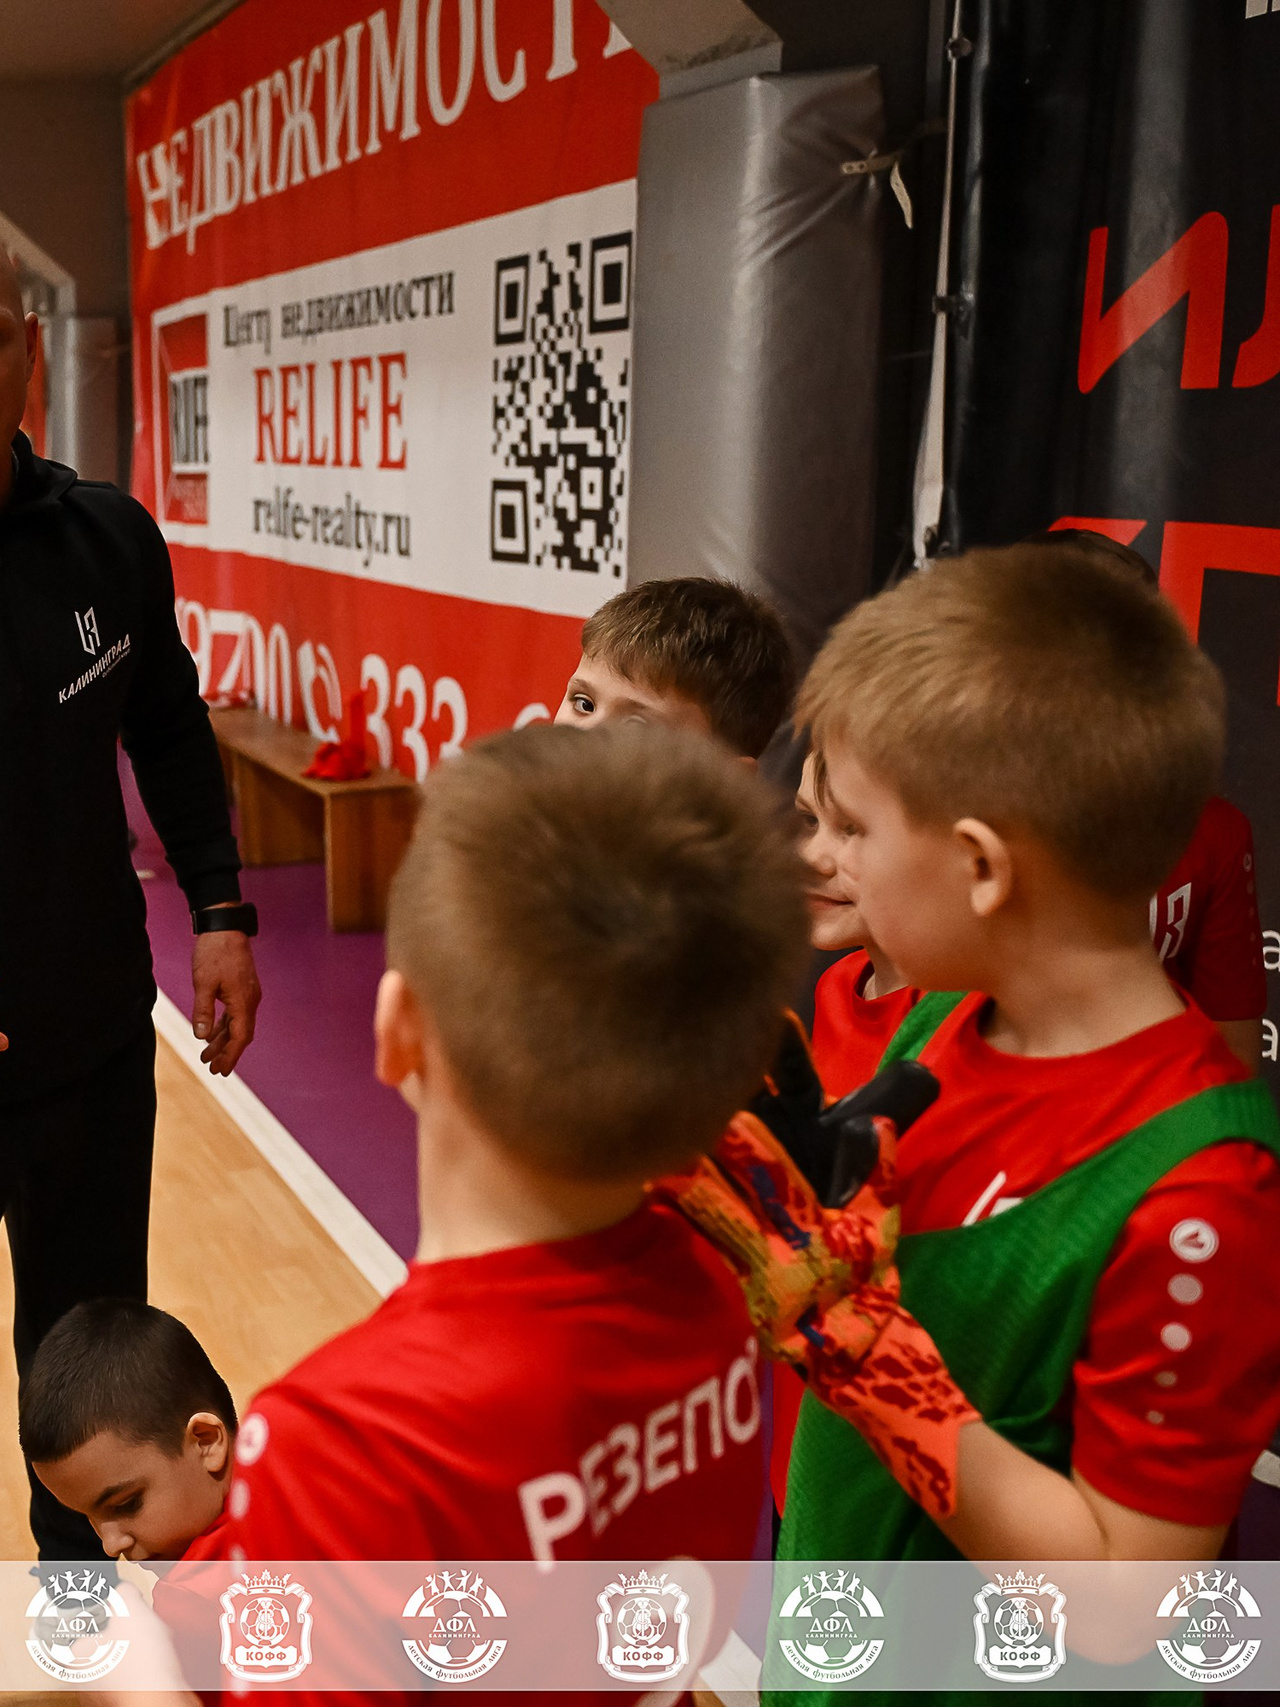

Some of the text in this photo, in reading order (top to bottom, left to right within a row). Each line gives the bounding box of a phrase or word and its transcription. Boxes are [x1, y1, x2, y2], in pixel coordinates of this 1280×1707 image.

[136, 0, 632, 255] НЕДВИЖИМОС
[253, 352, 407, 470] RELIFE
[59, 634, 130, 704] КАЛИНИНГРАД
[517, 1335, 760, 1574] РЕЗЕПО
